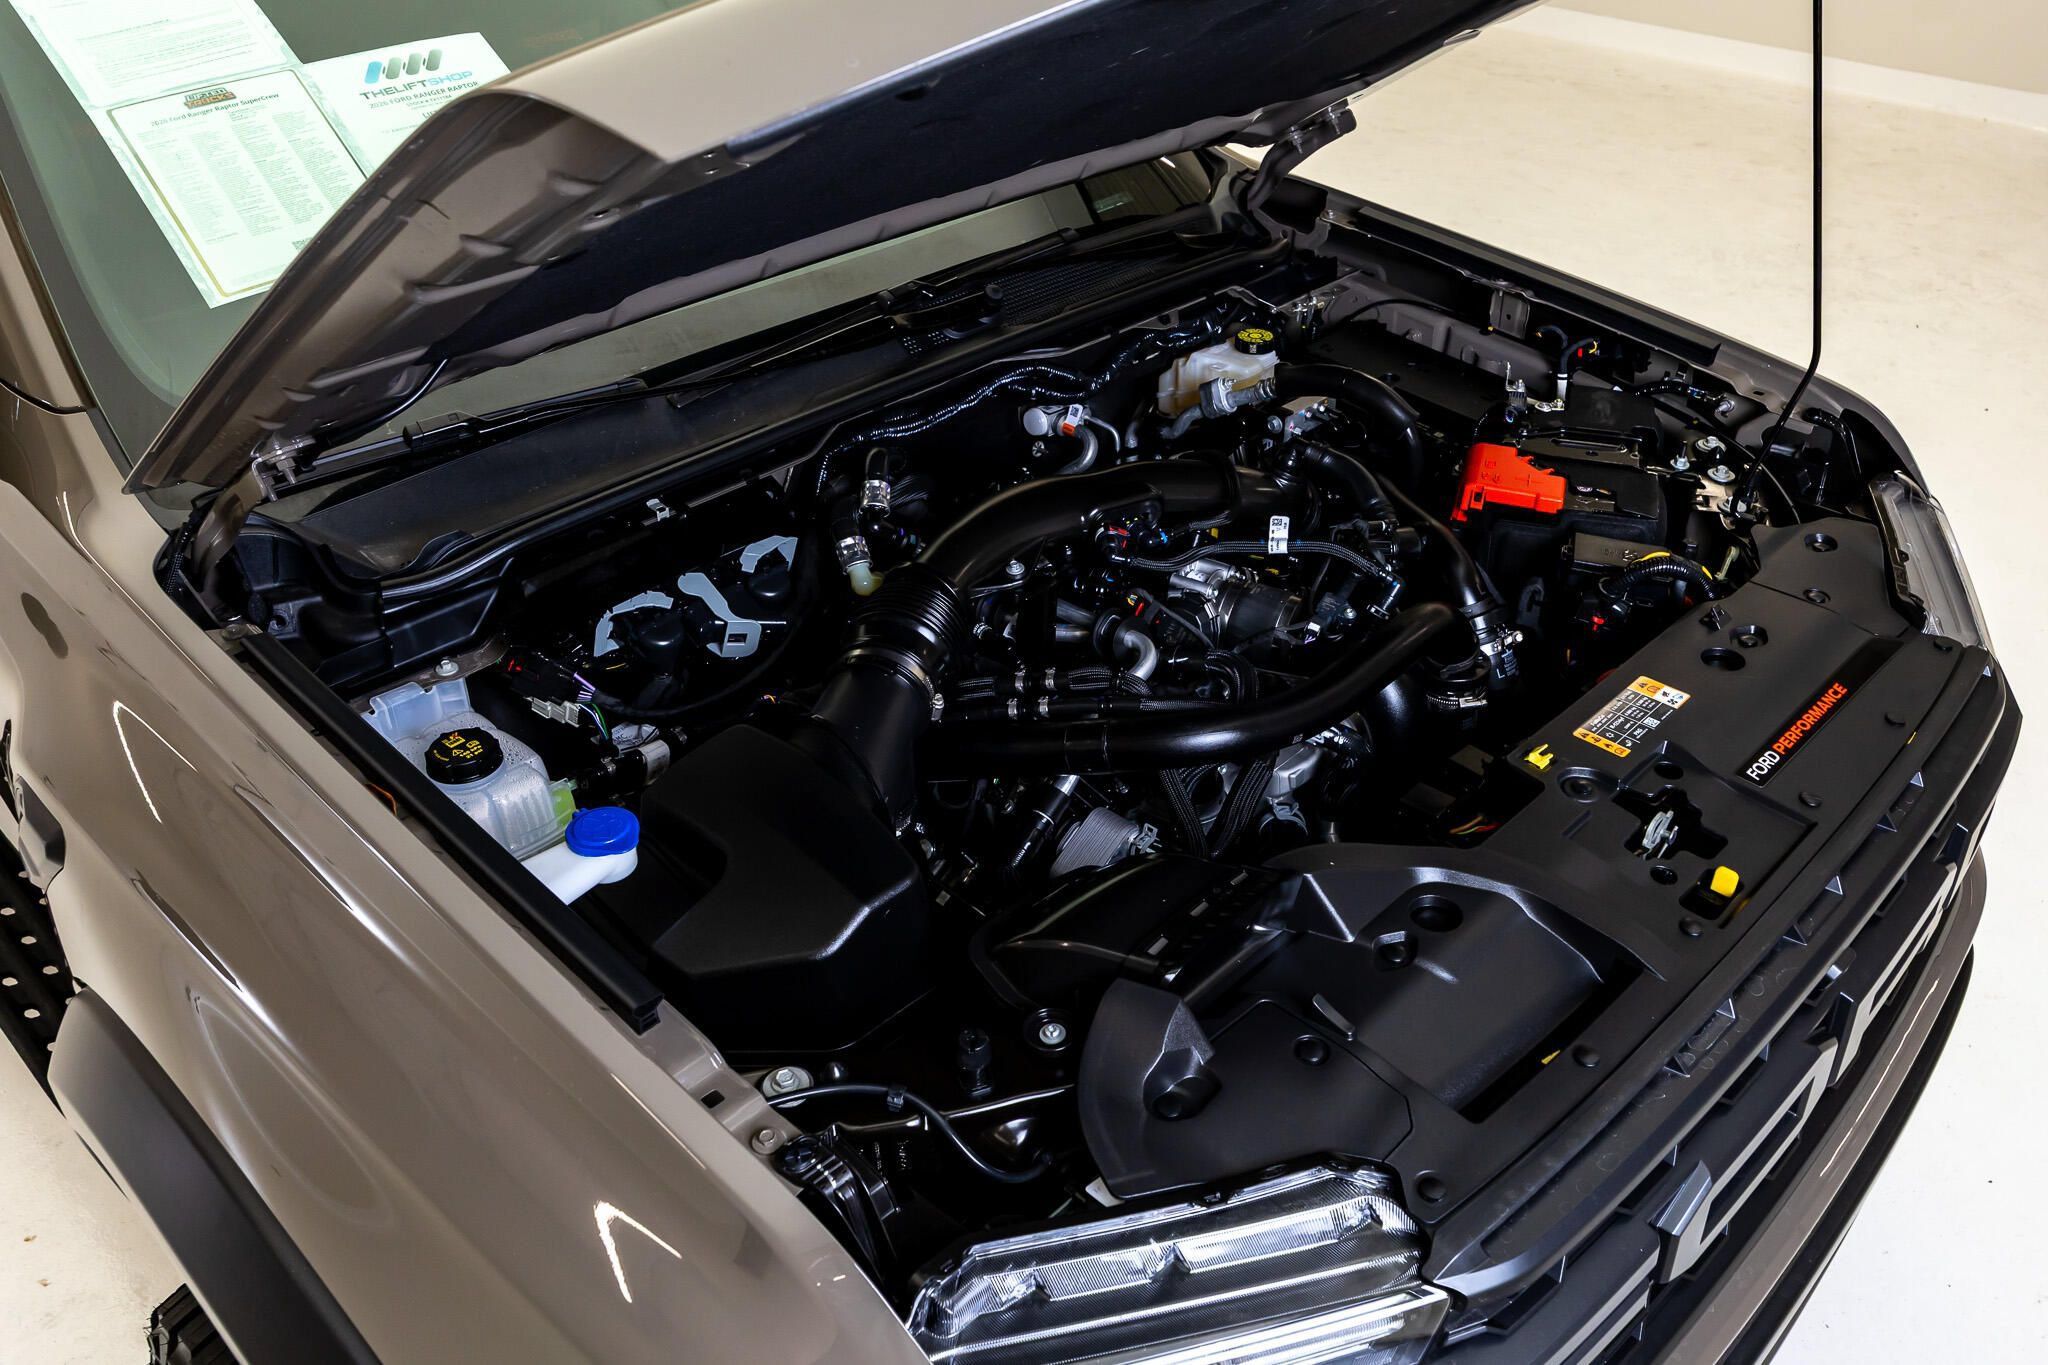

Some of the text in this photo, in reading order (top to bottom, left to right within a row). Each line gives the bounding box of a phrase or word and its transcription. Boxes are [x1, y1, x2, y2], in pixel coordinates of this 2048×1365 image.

[187, 106, 214, 118] Ranger
[214, 102, 240, 113] Raptor
[240, 93, 280, 107] SuperCrew
[390, 95, 413, 106] FORD
[413, 88, 447, 99] RANGER
[447, 80, 479, 93] RAPTOR
[1746, 682, 1848, 781] FORD PERFORMANCE
